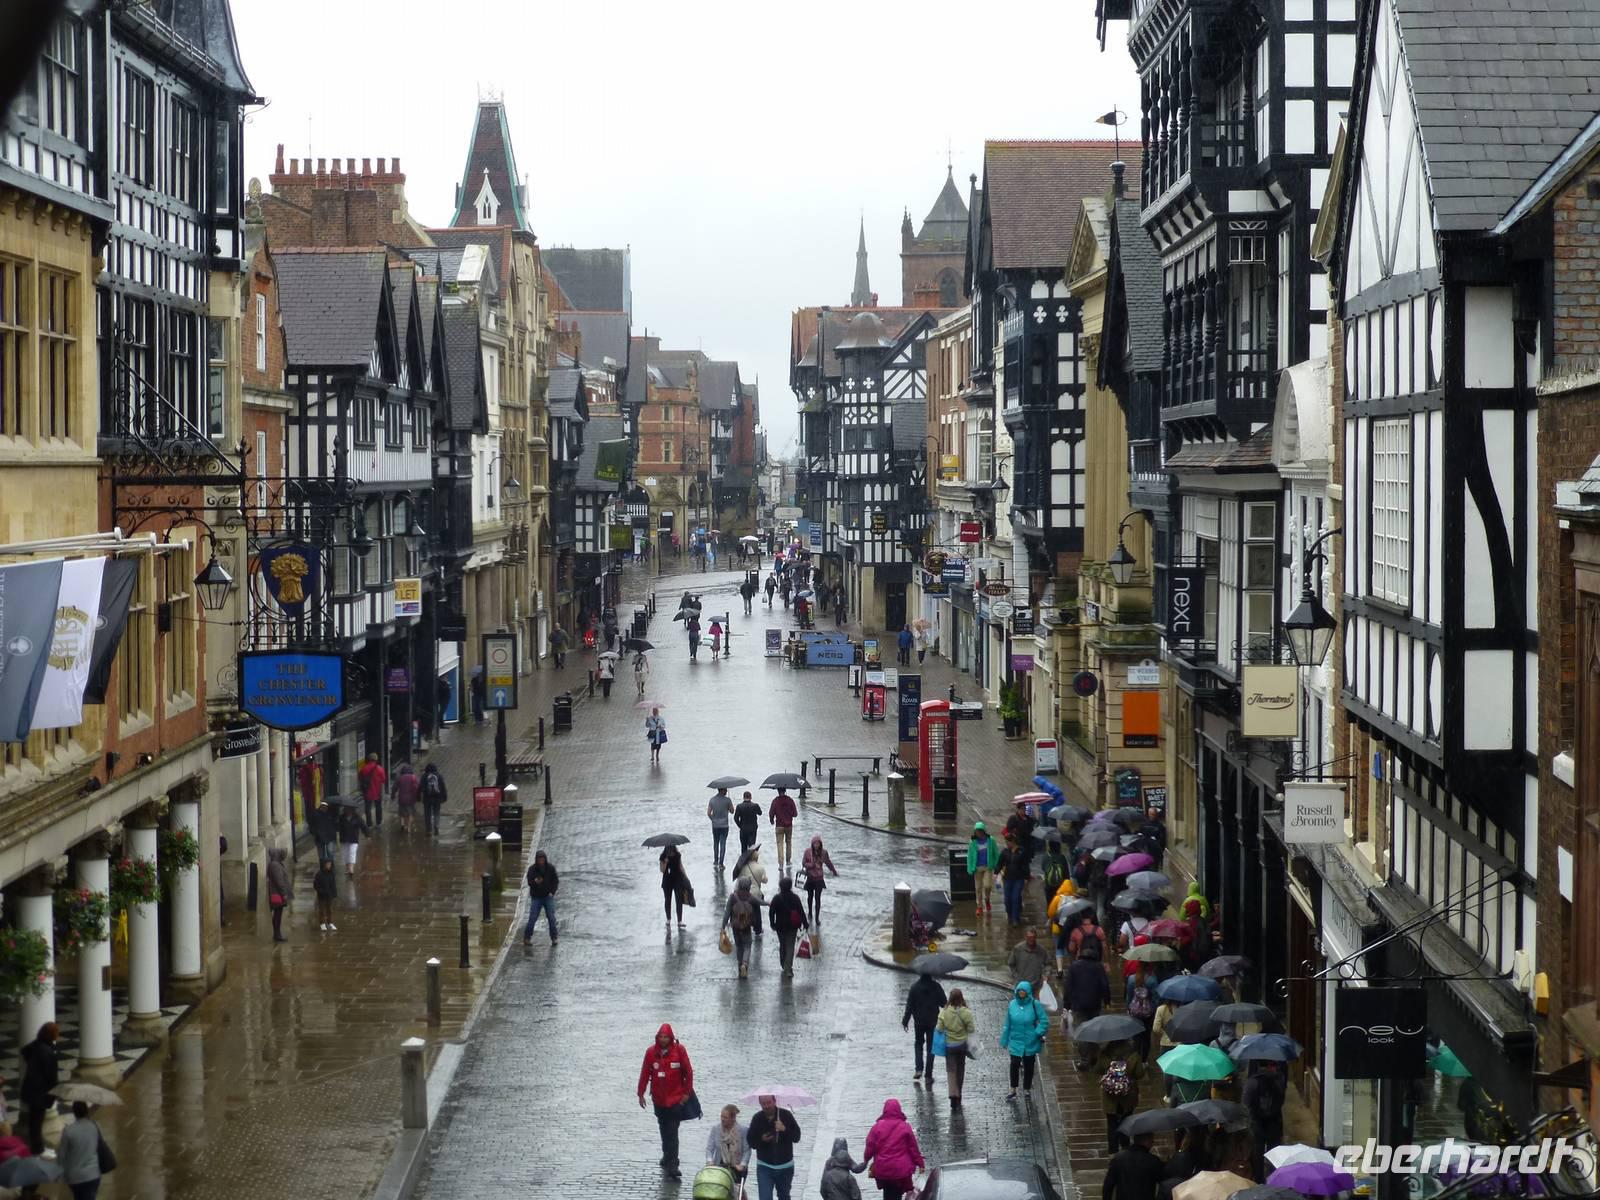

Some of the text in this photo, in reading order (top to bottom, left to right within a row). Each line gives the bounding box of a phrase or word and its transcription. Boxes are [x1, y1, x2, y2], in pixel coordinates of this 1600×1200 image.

[1173, 577, 1191, 632] next
[277, 664, 306, 674] THE
[258, 679, 326, 689] CHESTER
[248, 695, 337, 705] GROSVENOR
[1296, 804, 1333, 816] Russell
[1339, 1025, 1424, 1035] new
